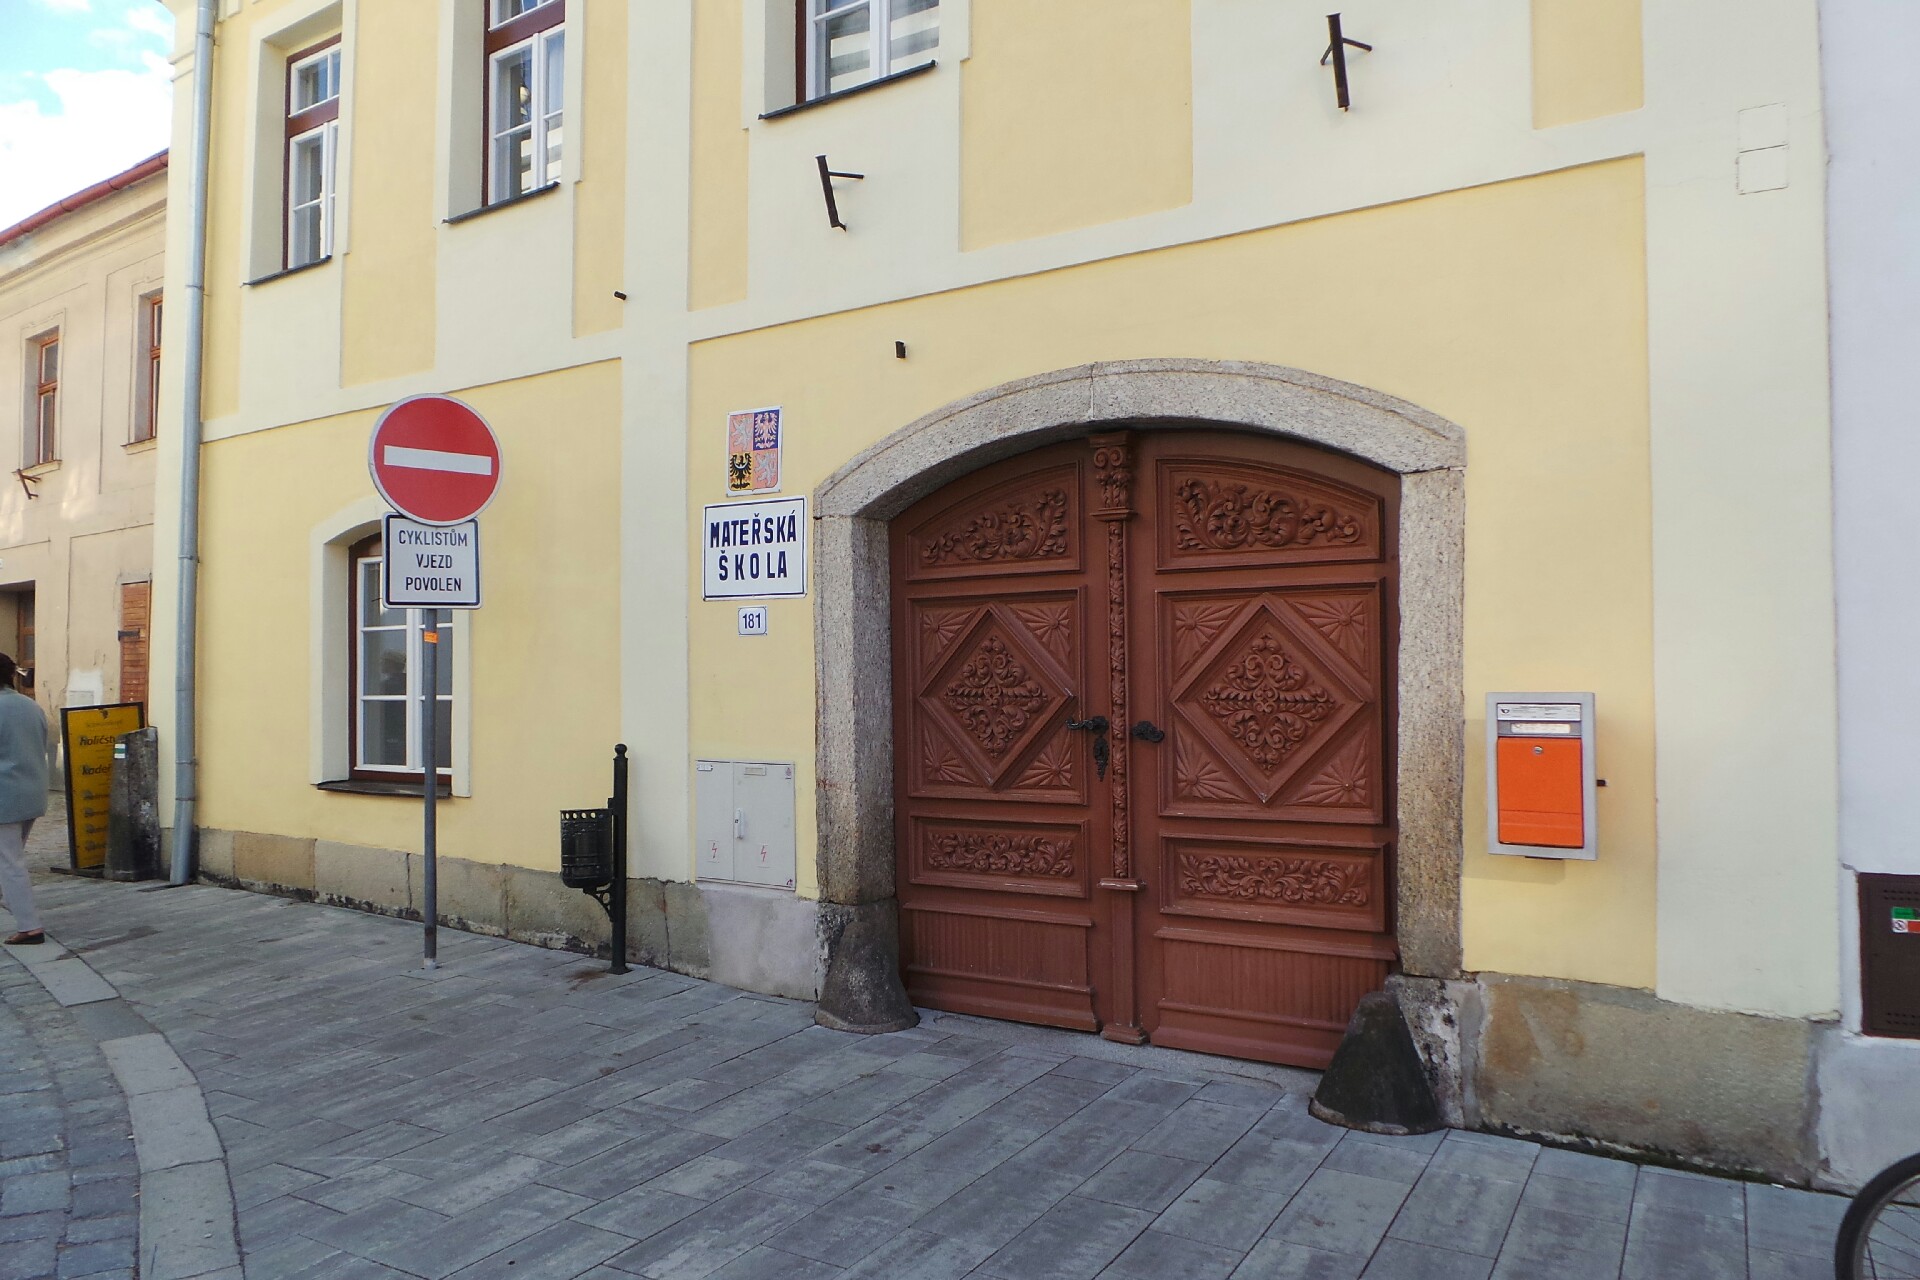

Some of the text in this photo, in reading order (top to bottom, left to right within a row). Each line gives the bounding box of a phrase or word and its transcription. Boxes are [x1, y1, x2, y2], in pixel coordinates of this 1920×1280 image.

[398, 528, 468, 547] CYKLISTŮM
[710, 509, 797, 548] MATEŘSKÁ
[416, 553, 453, 569] VJEZD
[718, 549, 788, 581] ŠKOLA
[405, 576, 462, 592] POVOLEN
[742, 612, 762, 629] 181
